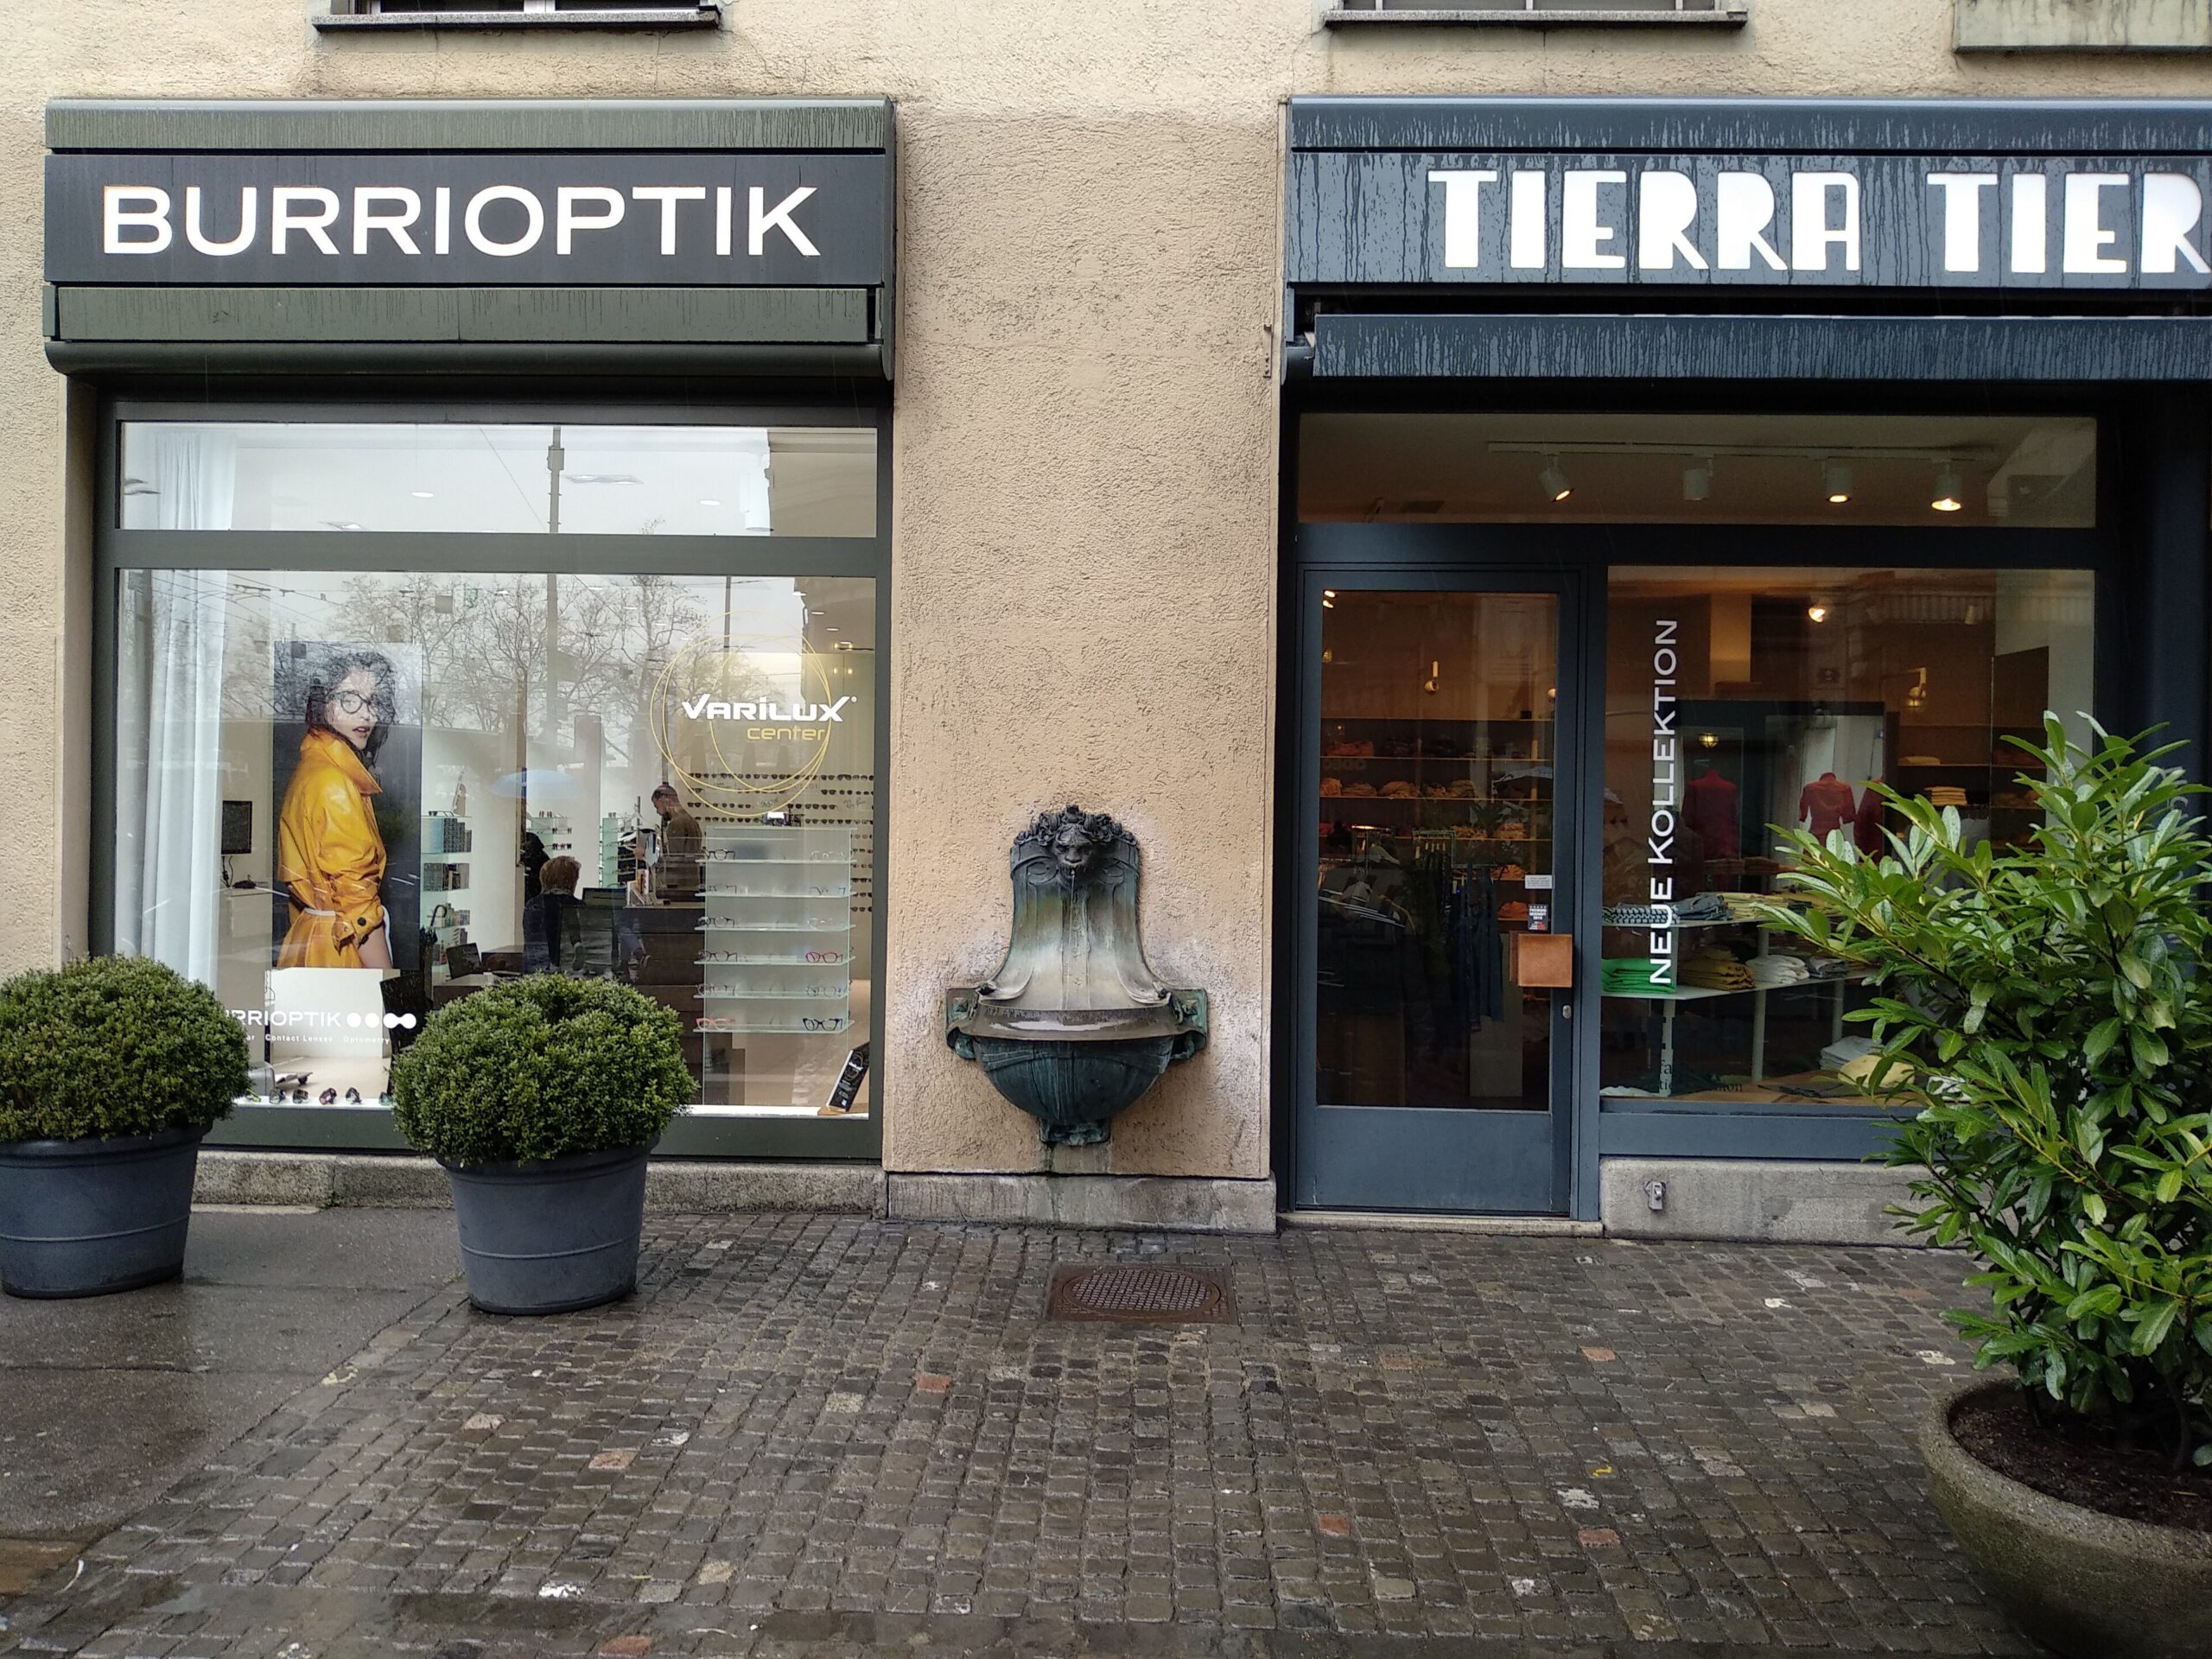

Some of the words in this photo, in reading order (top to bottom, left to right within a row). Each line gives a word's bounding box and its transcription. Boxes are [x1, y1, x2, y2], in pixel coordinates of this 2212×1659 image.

[104, 185, 821, 257] BURRIOPTIK
[1427, 170, 1860, 271] TIERRA
[1927, 173, 2212, 275] TIER
[747, 726, 825, 741] center
[1647, 620, 1678, 864] KOLLEKTION
[1649, 877, 1674, 984] NEUE
[225, 1009, 344, 1027] RRIOPTIK
[264, 1033, 300, 1042] Contact
